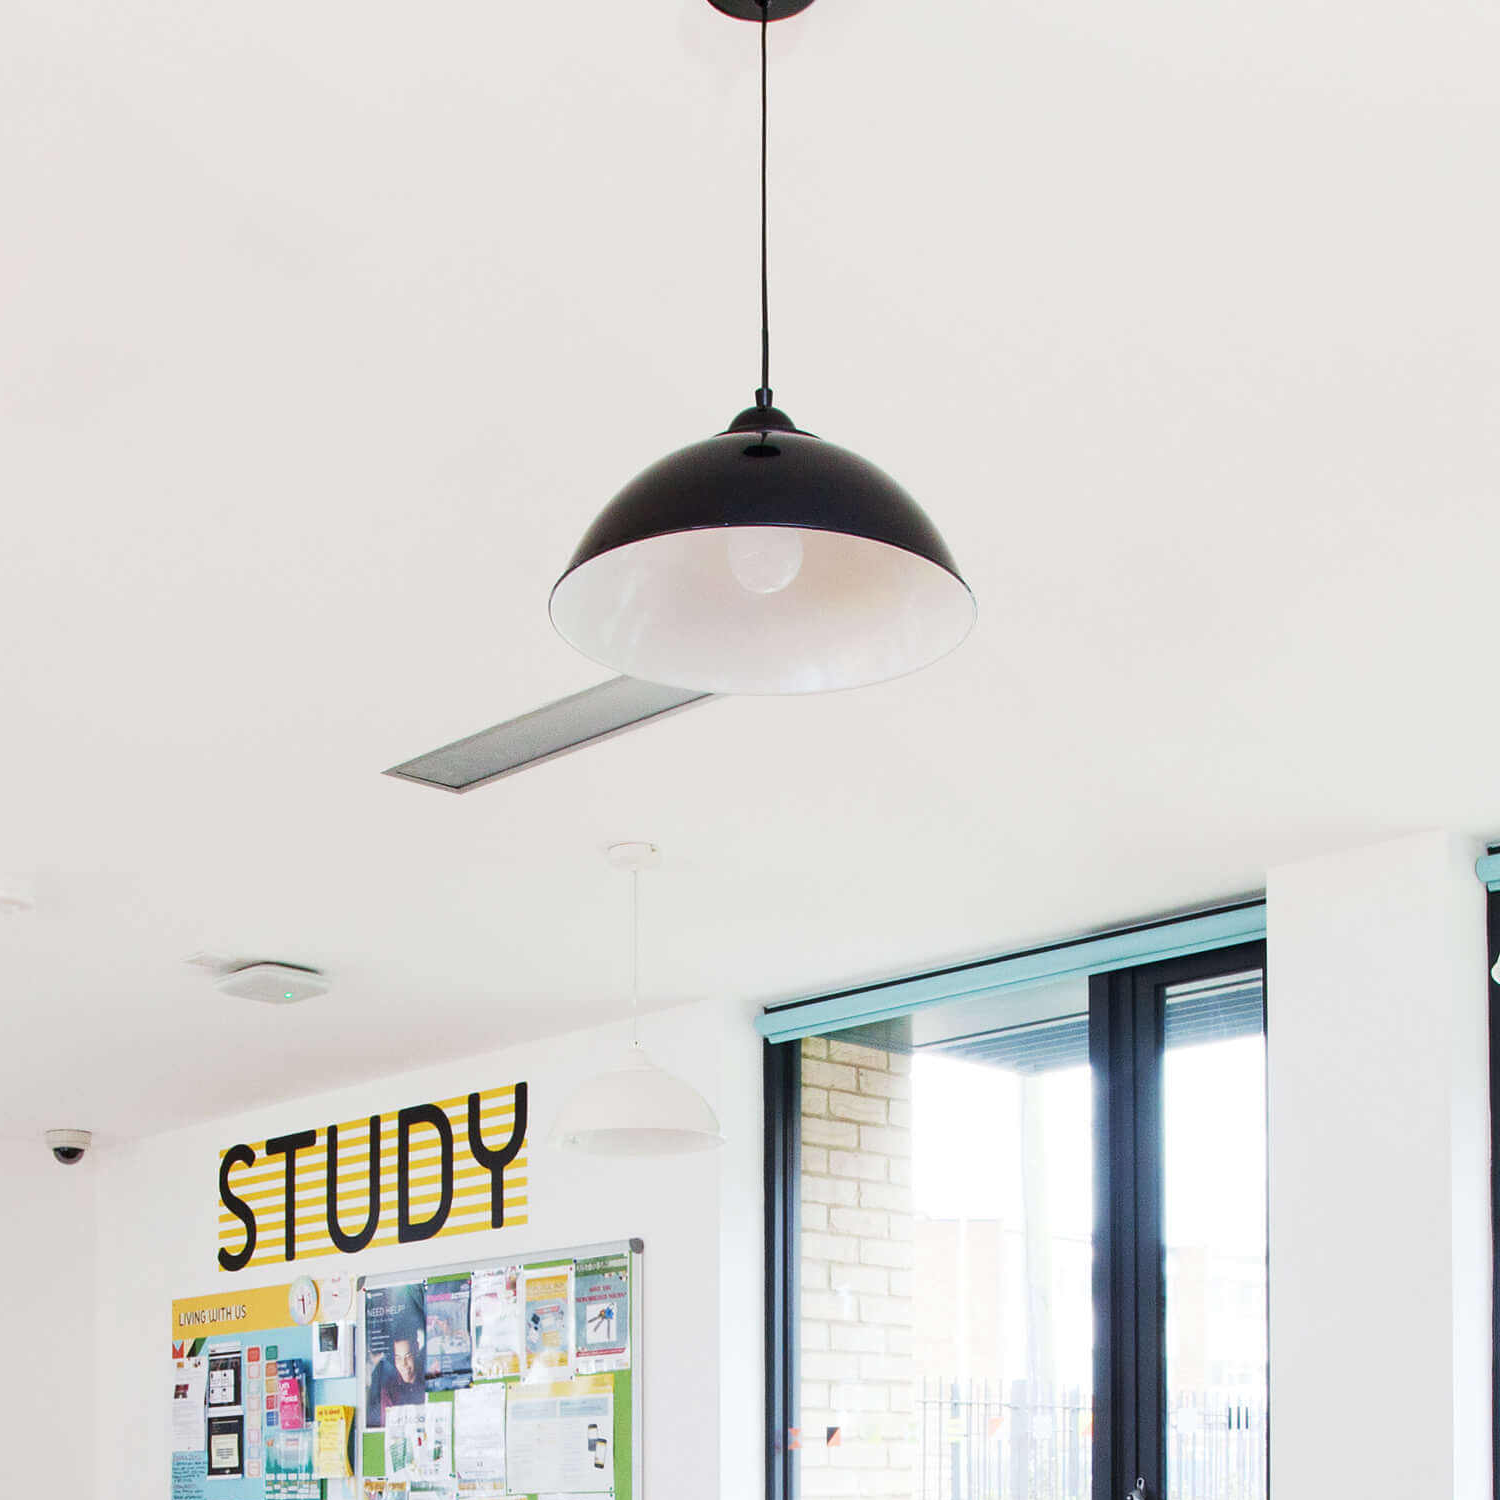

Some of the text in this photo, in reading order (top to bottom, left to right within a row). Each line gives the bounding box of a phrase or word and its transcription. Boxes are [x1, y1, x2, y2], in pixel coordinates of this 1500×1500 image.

[217, 1081, 528, 1272] STUDY
[179, 1305, 247, 1326] LIVING WITH US
[367, 1306, 385, 1317] NEED
